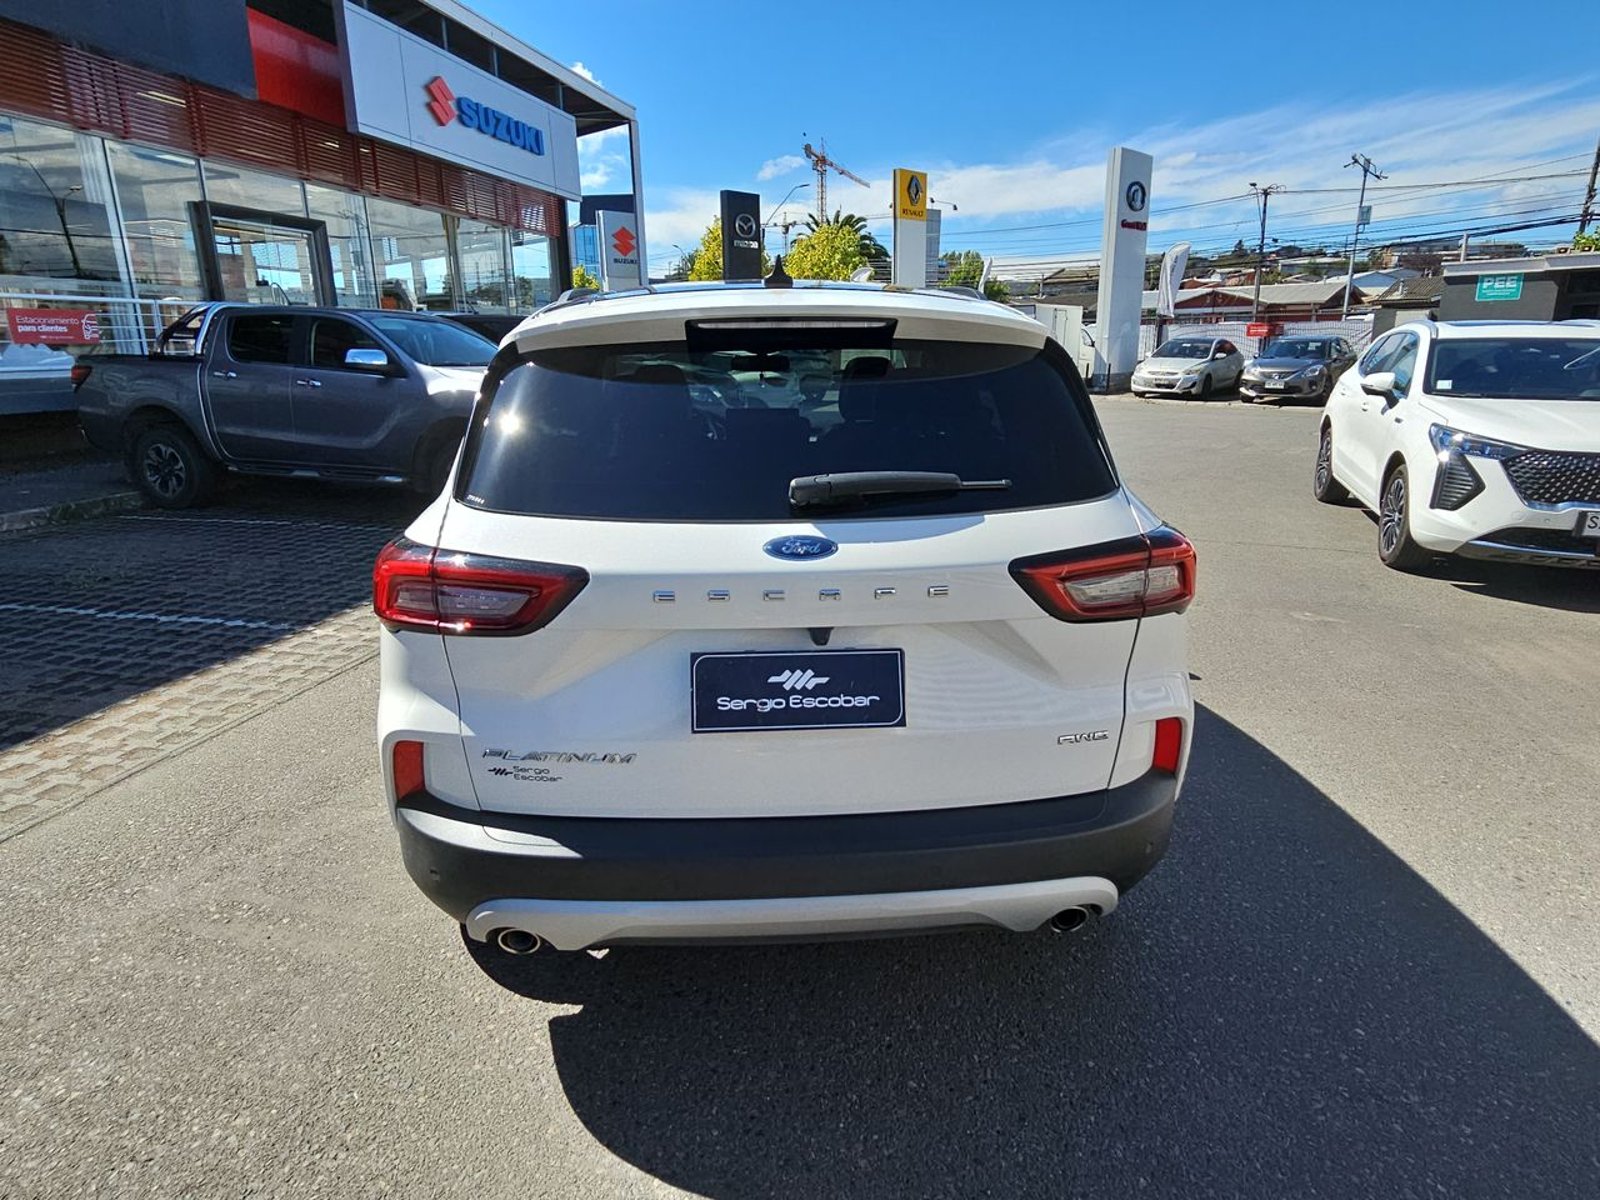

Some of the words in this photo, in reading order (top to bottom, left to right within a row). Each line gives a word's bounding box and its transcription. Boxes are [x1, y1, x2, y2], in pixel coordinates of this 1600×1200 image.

[456, 96, 545, 156] SUZUKI
[1482, 275, 1517, 289] PEE
[18, 325, 37, 333] para
[781, 536, 821, 555] Ford
[652, 585, 949, 602] ESCAPE
[717, 696, 786, 712] Sergio
[789, 693, 880, 709] Escobar
[482, 749, 637, 764] PLATINUM
[513, 773, 563, 782] Escobar
